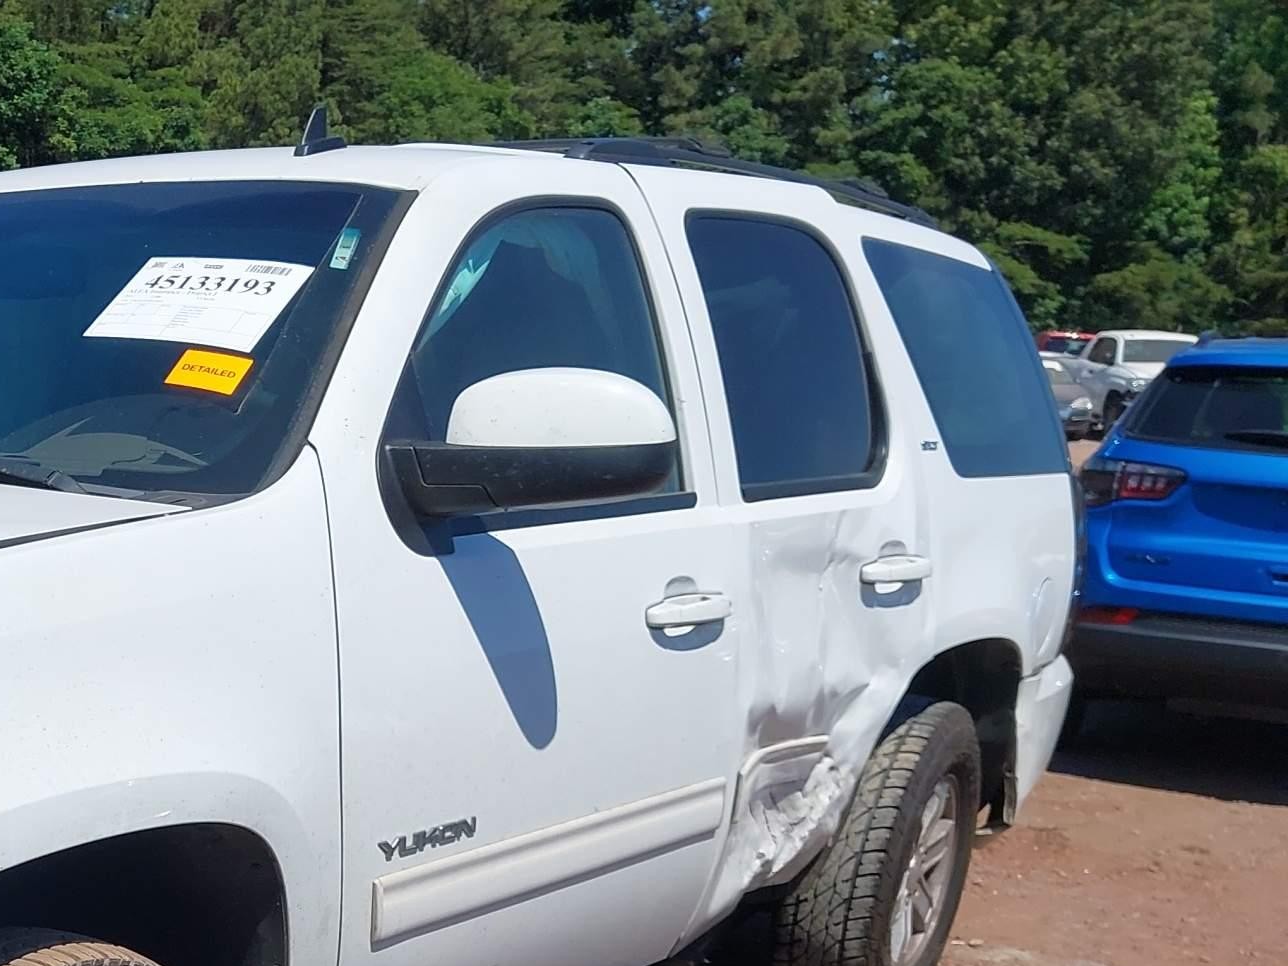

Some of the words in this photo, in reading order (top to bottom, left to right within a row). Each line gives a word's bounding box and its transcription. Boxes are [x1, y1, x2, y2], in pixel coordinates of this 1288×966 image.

[144, 274, 277, 296] 45133193
[181, 363, 237, 379] DETAILED
[377, 816, 477, 862] YUKON
